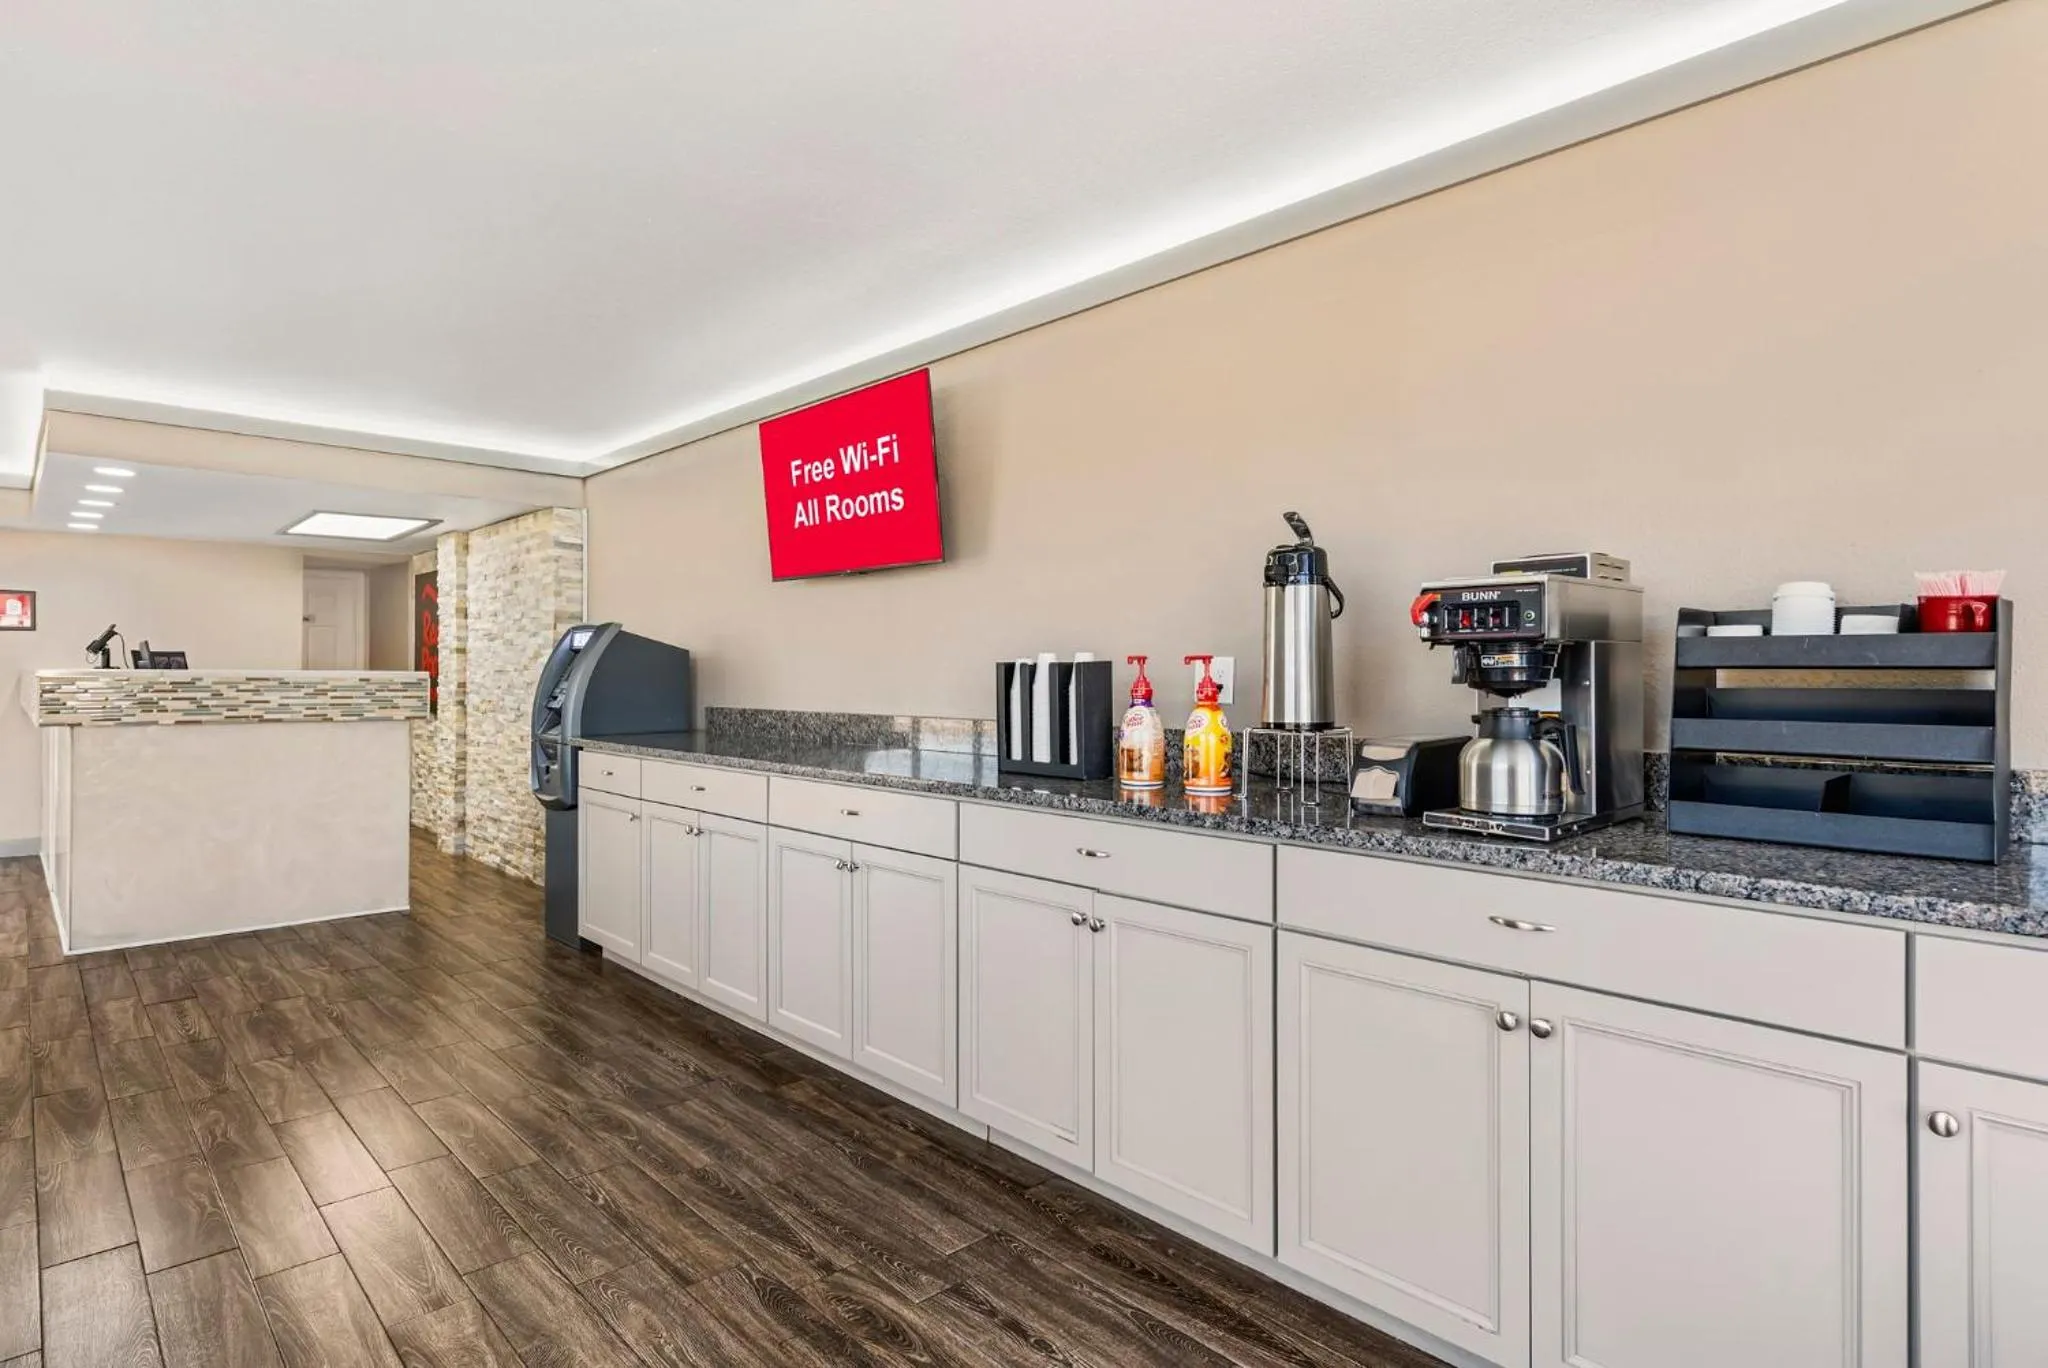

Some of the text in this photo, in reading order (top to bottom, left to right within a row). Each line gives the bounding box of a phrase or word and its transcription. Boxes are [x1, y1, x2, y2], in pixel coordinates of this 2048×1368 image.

[791, 433, 899, 487] Free Wi-Fi
[794, 487, 905, 529] All Rooms
[1461, 591, 1498, 601] BUNN
